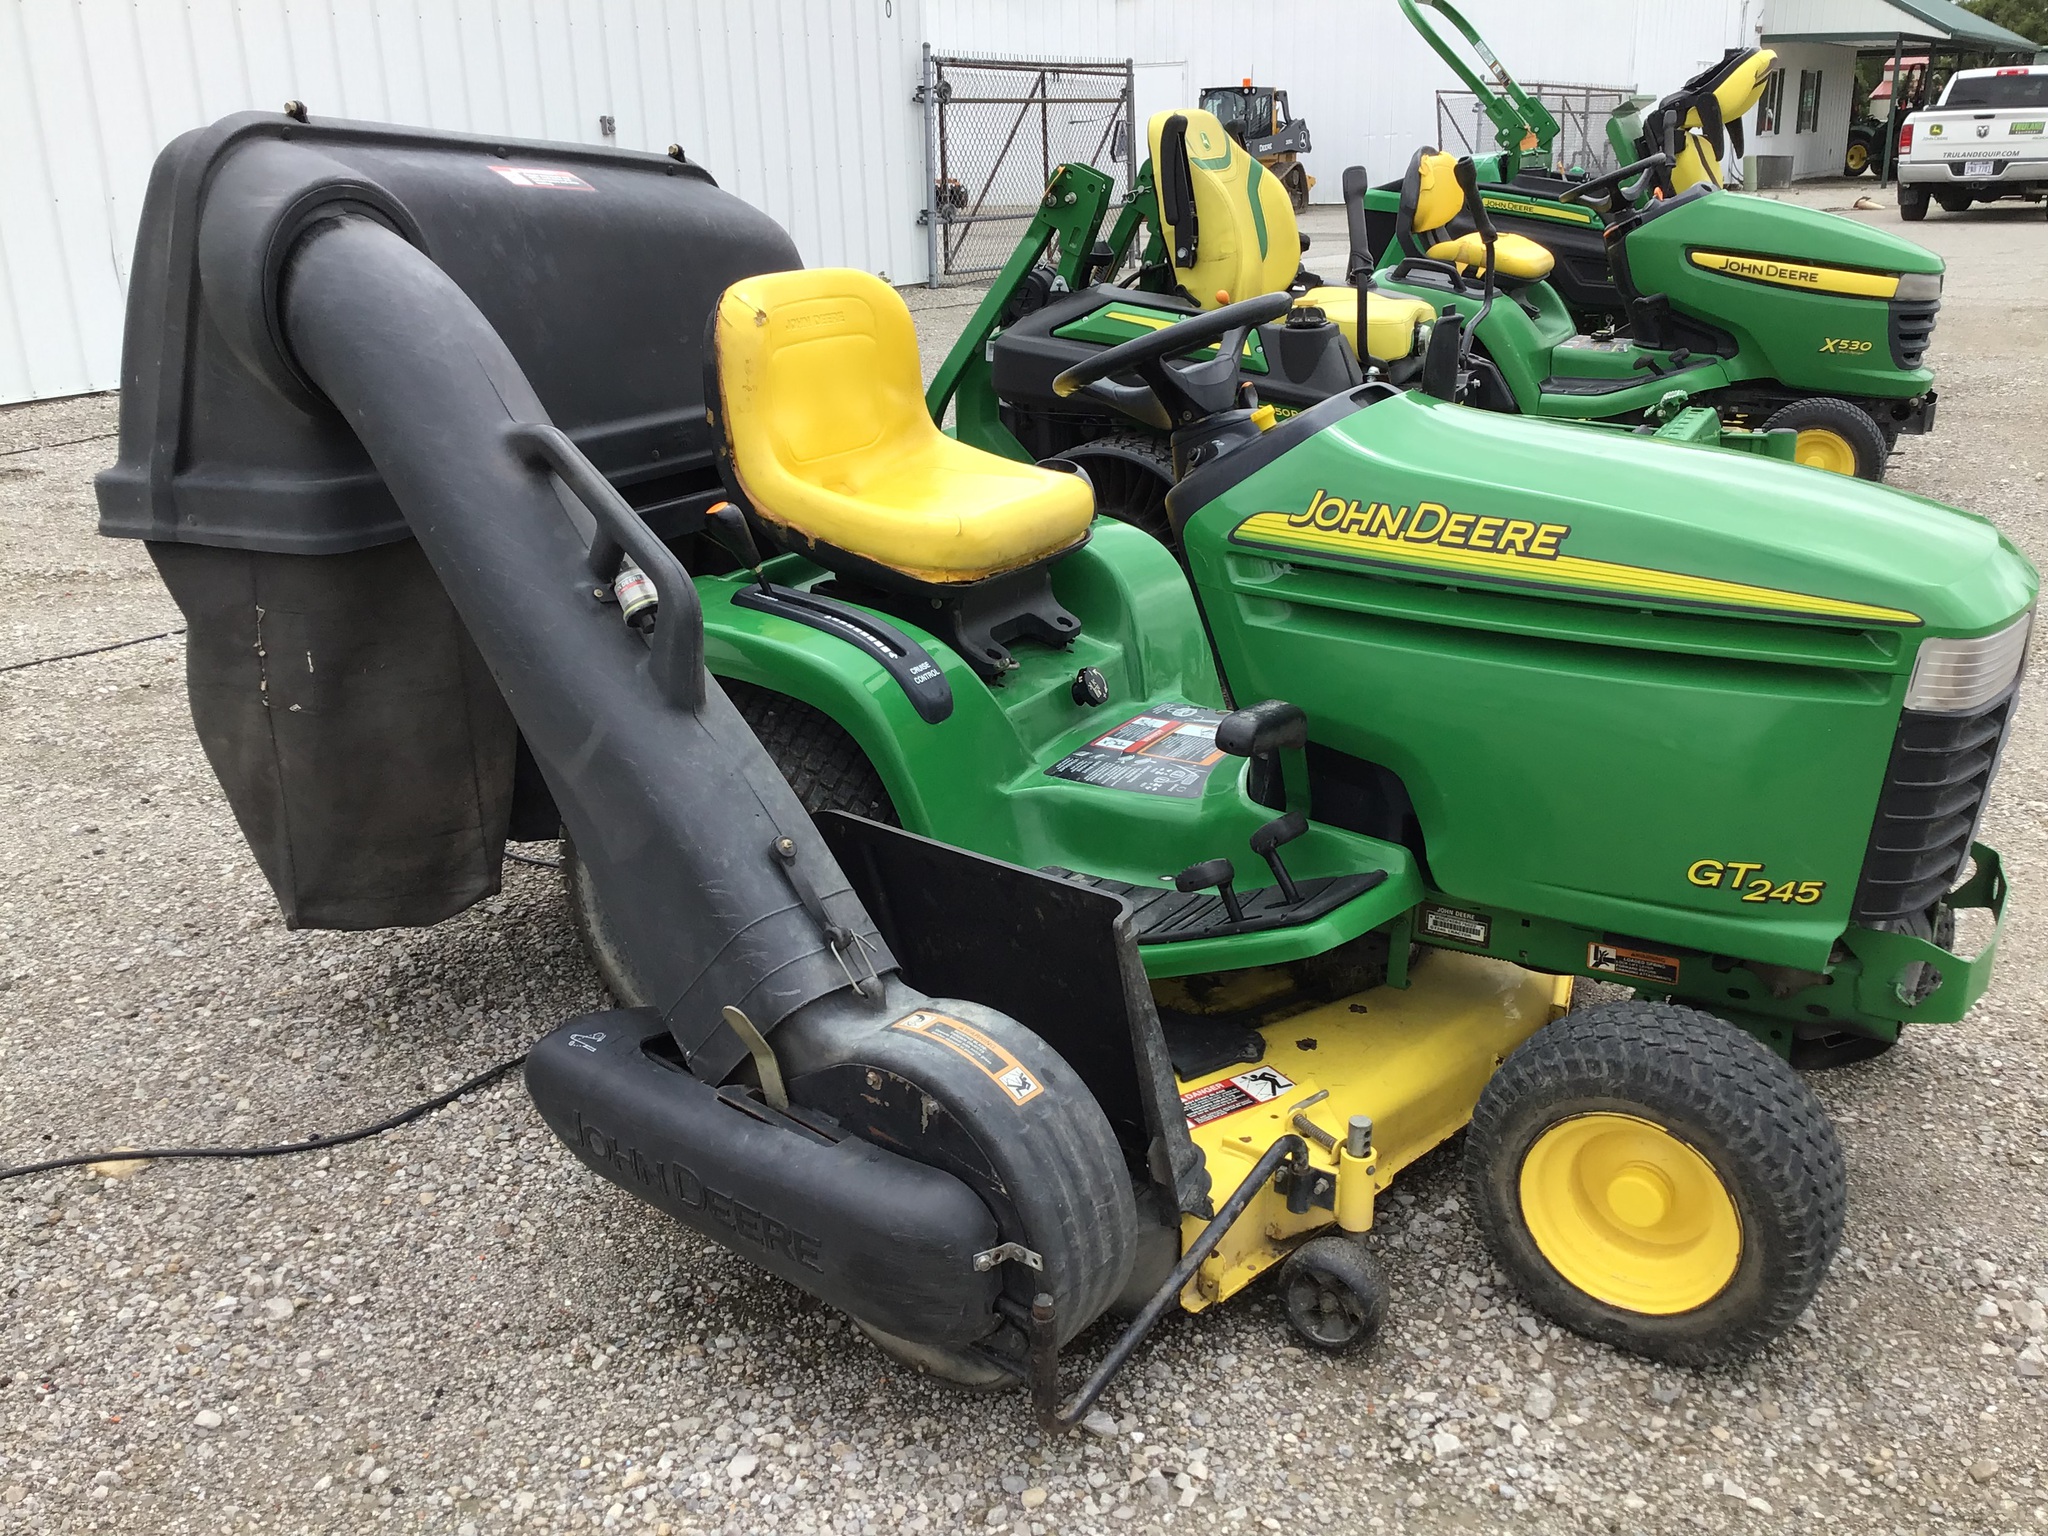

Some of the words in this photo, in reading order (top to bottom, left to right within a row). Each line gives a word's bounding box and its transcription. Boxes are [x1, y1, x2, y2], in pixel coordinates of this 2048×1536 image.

[2011, 122, 2044, 131] TRULAND
[1943, 150, 2020, 159] TRULANDEQUIP.COM
[1484, 200, 1506, 209] JOHN
[1507, 202, 1534, 212] DEERE
[1719, 258, 1763, 275] JOHN
[1765, 265, 1819, 283] DEERE
[785, 316, 811, 332] JOHN
[813, 311, 845, 327] DEERE
[1818, 337, 1873, 353] X530
[1288, 489, 1411, 539] JOHN
[1403, 501, 1571, 560] DEERE
[909, 661, 932, 675] CRUISE
[914, 669, 941, 685] CONTROL
[1687, 858, 1827, 905] GT245
[1437, 907, 1453, 915] JOHN
[1455, 911, 1475, 919] DEERE
[964, 1027, 996, 1048] WARNING
[1184, 1083, 1224, 1100] DANGER
[573, 1108, 669, 1197] JOHN
[672, 1161, 824, 1274] DEERE
